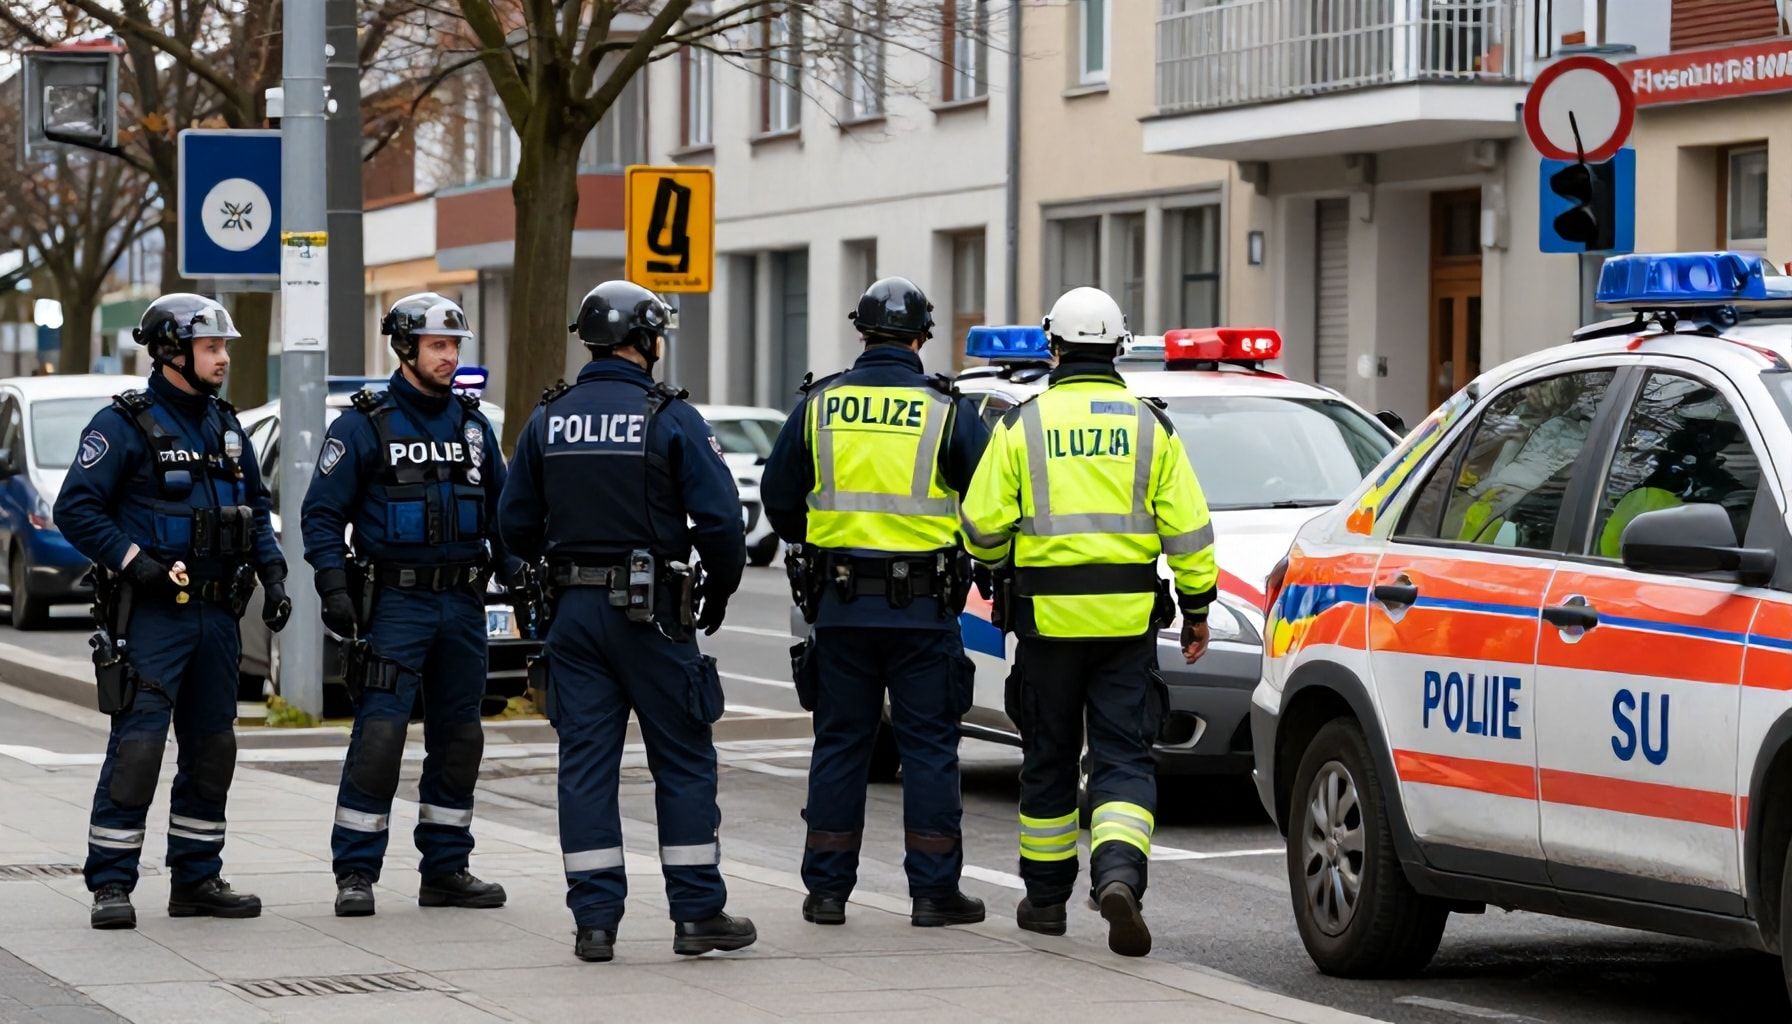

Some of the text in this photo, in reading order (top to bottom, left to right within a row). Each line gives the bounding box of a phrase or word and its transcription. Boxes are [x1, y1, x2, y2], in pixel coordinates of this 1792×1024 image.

[826, 396, 924, 427] POLIZE
[548, 414, 644, 444] POLICE
[389, 441, 465, 466] POLIE
[1611, 688, 1670, 766] SU
